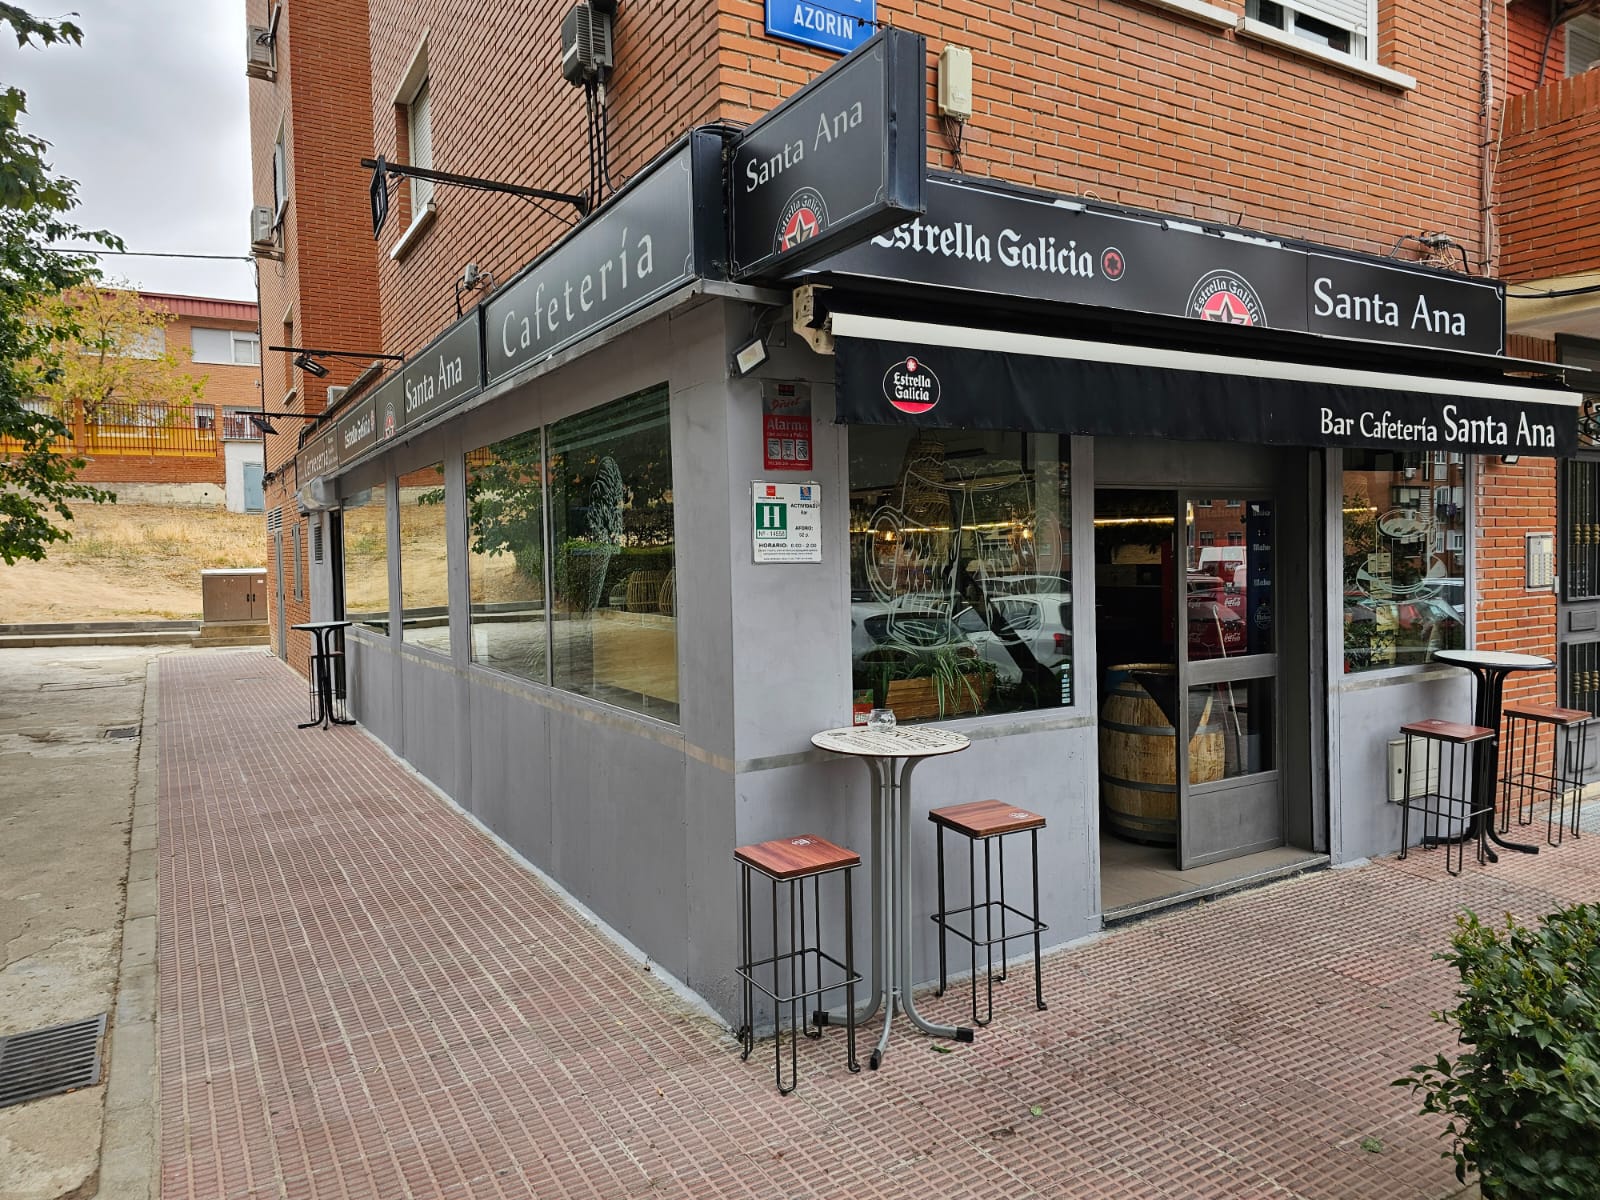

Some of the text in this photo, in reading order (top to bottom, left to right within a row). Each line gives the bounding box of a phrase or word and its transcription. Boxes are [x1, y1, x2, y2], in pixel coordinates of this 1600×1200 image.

[746, 101, 863, 193] Santa Ana
[997, 228, 1095, 279] Galicia
[502, 226, 654, 358] Cafetería
[1193, 279, 1259, 323] Estrella Galicia
[1313, 277, 1467, 337] Santa Ana
[406, 374, 435, 413] Santa
[437, 355, 463, 395] Ana
[893, 371, 932, 388] Estrella
[894, 385, 930, 401] Galicia
[767, 418, 809, 431] Alarma
[1320, 404, 1556, 448] Bar Cafetería Santa Ana
[762, 505, 780, 528] H
